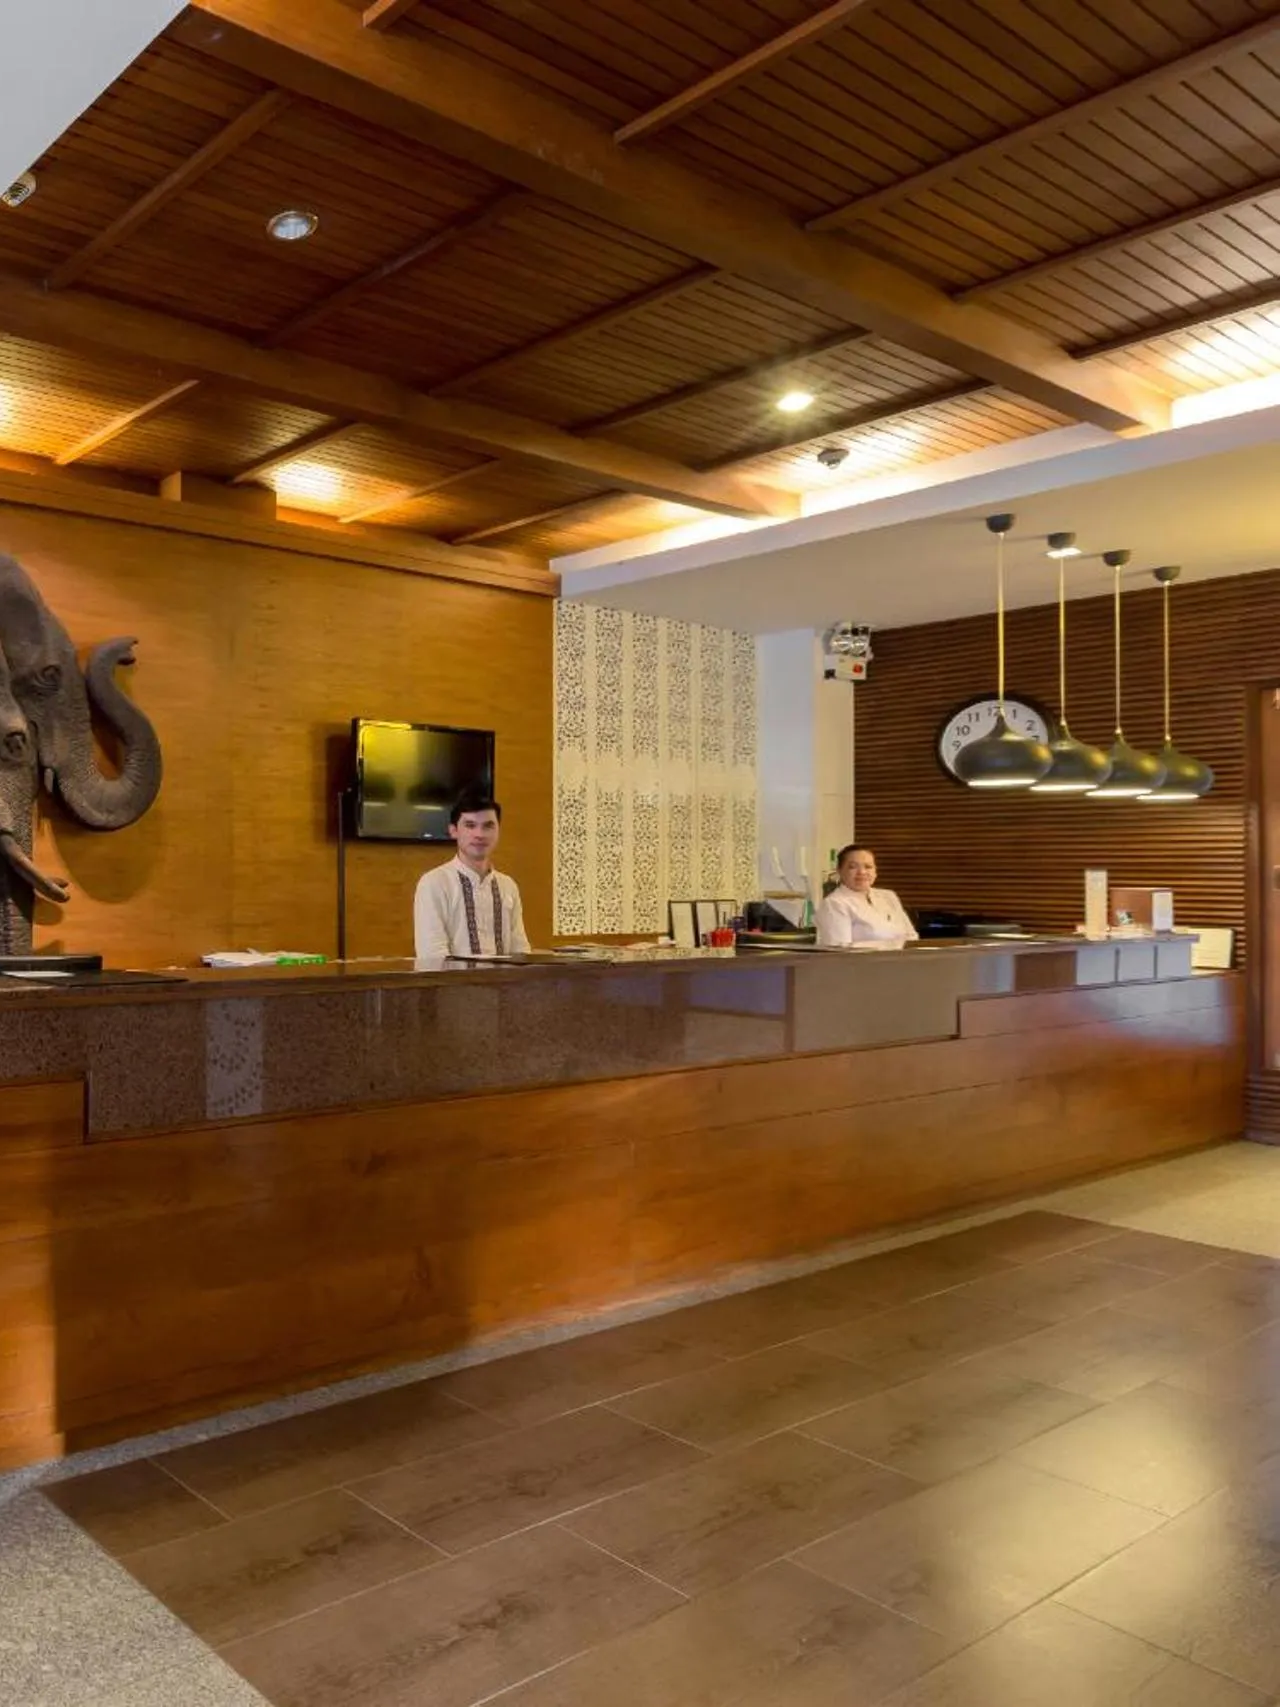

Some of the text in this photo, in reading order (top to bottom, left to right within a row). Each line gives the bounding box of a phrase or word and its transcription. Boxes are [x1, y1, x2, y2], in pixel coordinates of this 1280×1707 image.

[967, 712, 980, 723] 11
[1012, 708, 1017, 719] 1
[956, 725, 970, 737] 10
[1026, 720, 1035, 731] 2
[952, 740, 962, 751] 9
